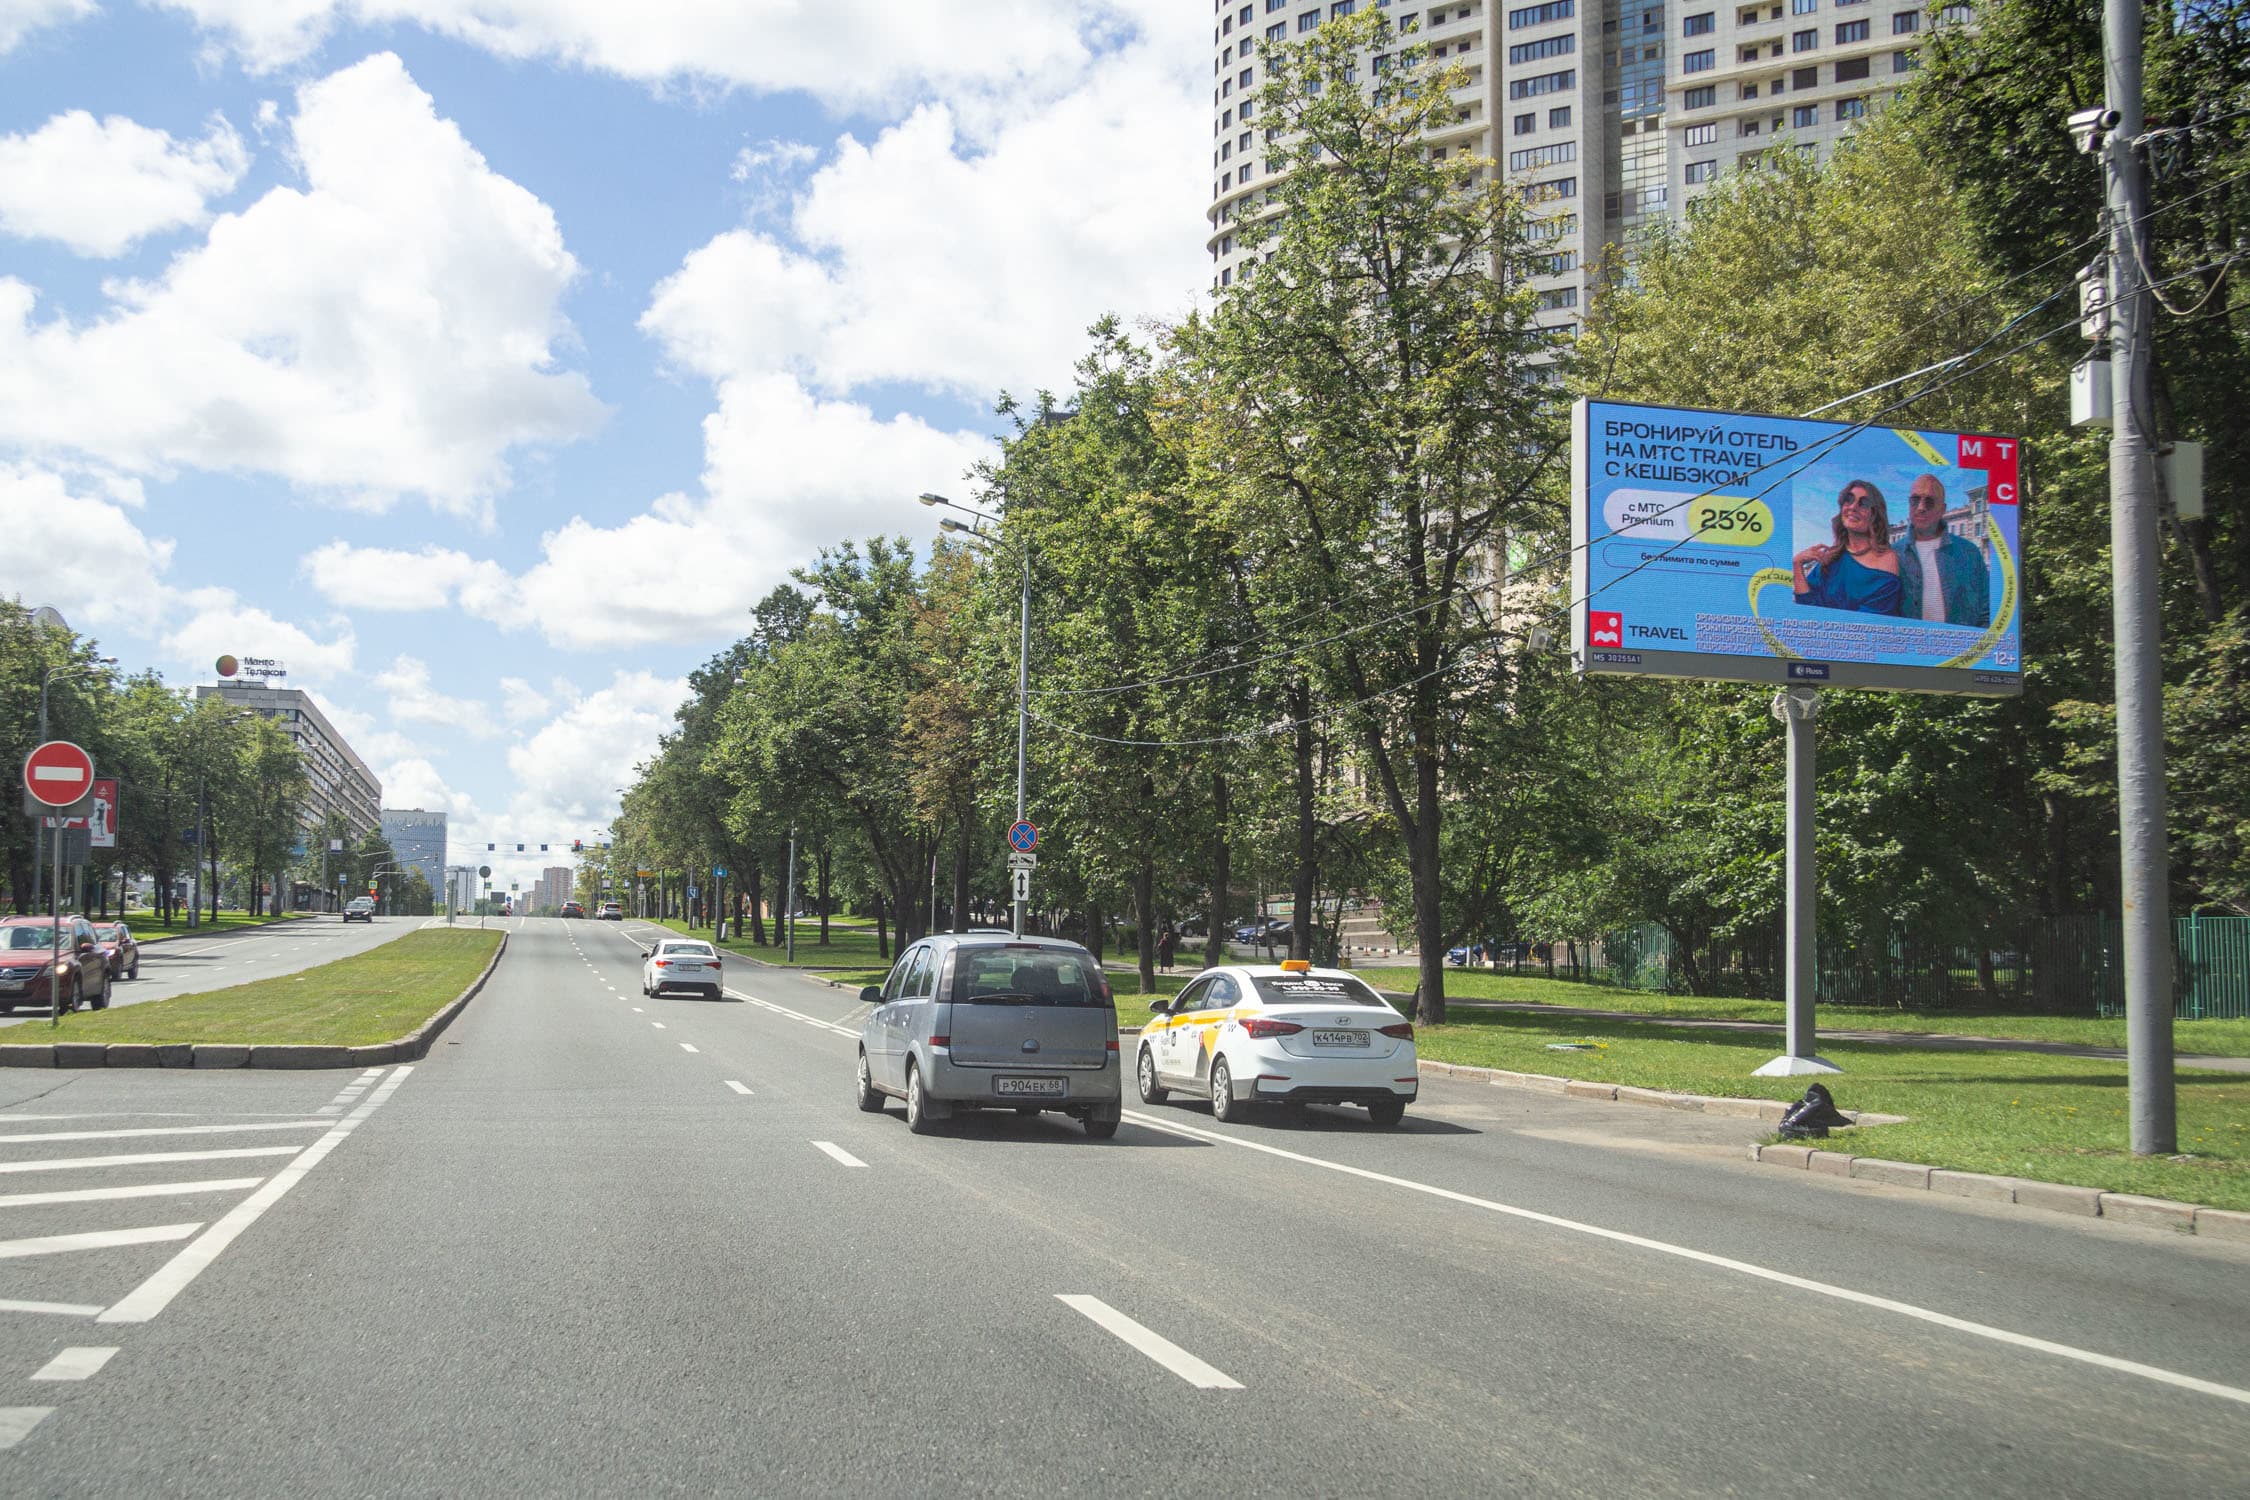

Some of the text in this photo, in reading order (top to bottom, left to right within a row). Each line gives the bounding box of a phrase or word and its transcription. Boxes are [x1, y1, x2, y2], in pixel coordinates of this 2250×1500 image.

[1605, 420, 1798, 450] БРОНИРУЙ ОТЕЛЬ
[1605, 441, 1765, 467] НА МТС TRAVEL
[1605, 461, 1749, 486] С КЕШБЭКОМ
[1638, 503, 1665, 513] МТС
[1622, 513, 1674, 527] Premium
[1700, 508, 1762, 533] 25%
[1659, 554, 1694, 564] лимита
[1696, 557, 1708, 565] по
[1709, 558, 1740, 568] сумме
[1628, 625, 1688, 640] TRAVEL
[244, 656, 275, 666] Манго
[1993, 651, 2016, 666] 12+
[244, 667, 287, 677] Телеком
[1002, 1080, 1046, 1092] Р904ЕК
